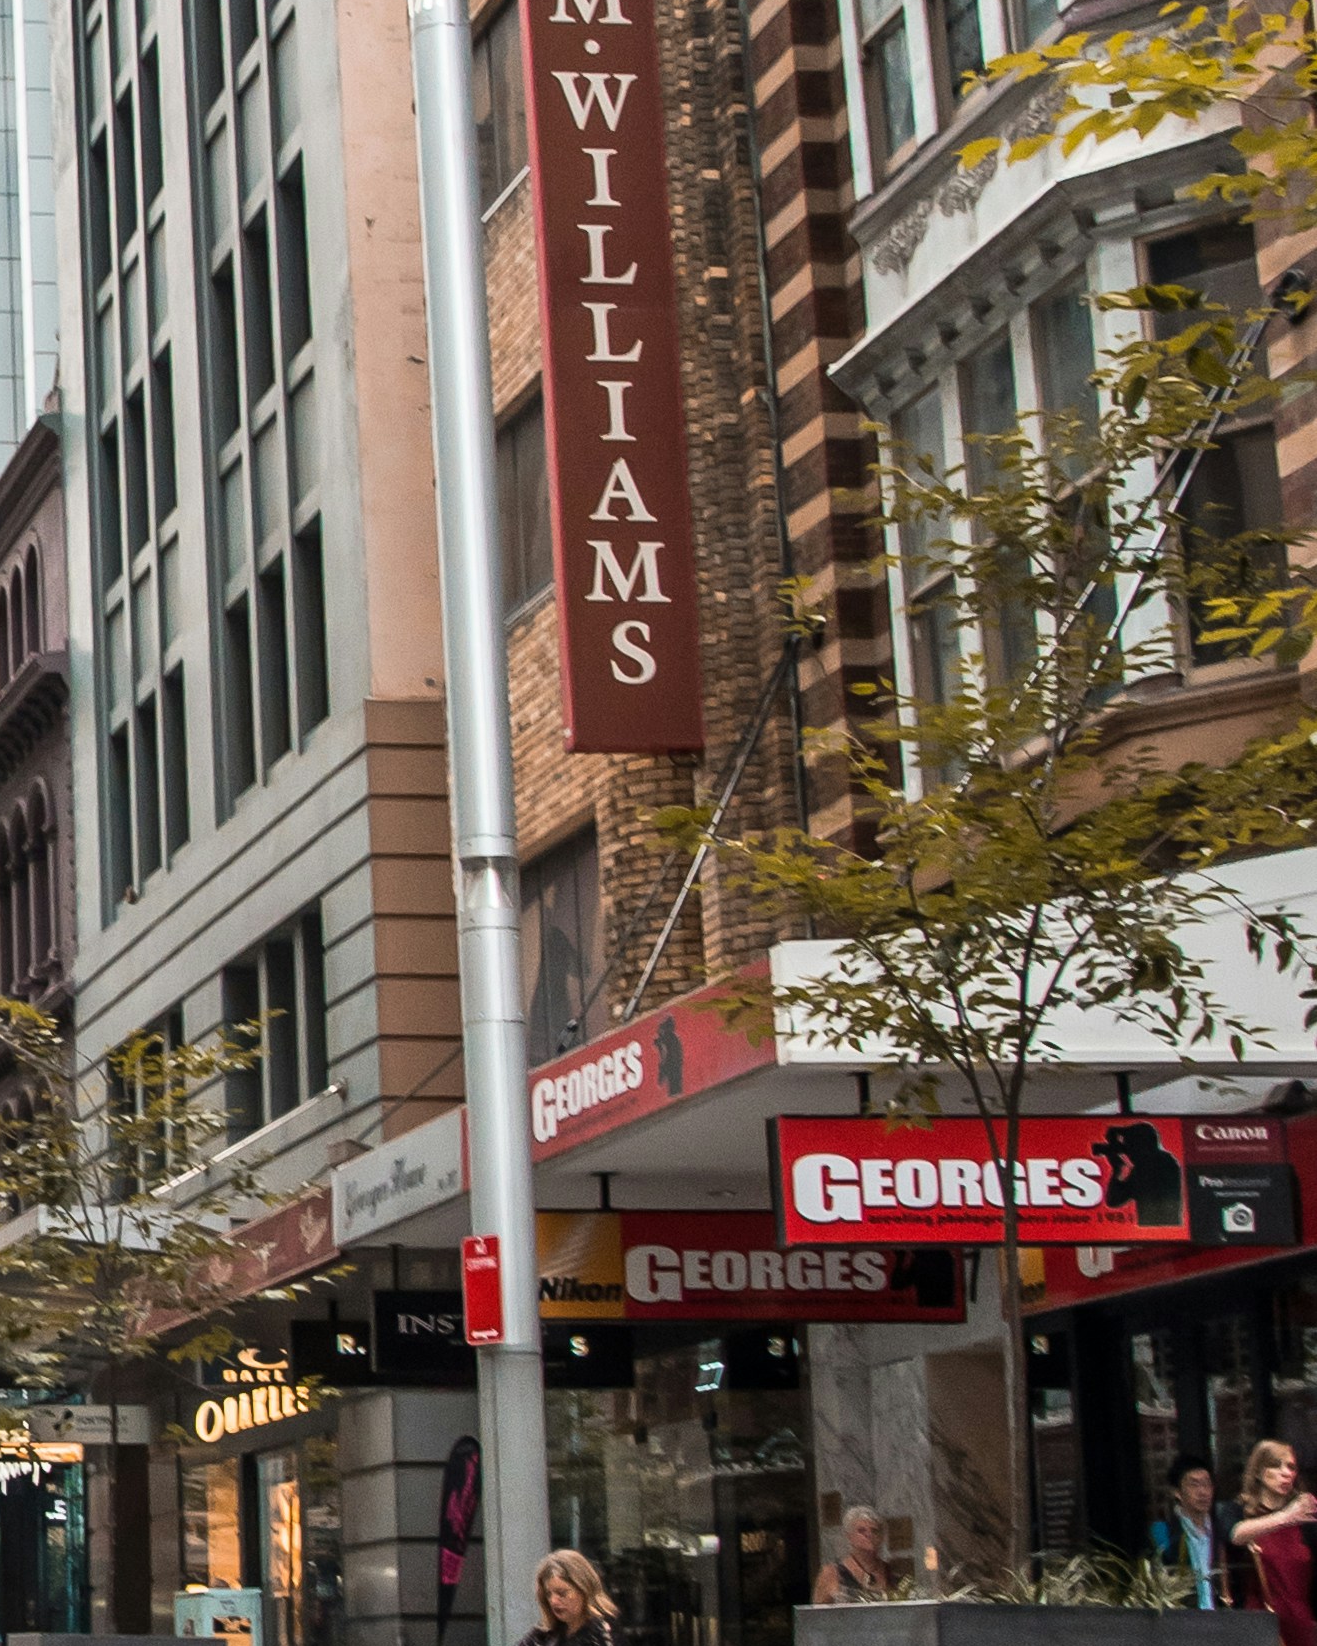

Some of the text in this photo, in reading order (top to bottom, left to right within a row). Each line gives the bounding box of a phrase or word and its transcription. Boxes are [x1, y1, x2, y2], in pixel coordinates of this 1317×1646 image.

[532, 1040, 644, 1144] GEORGES
[1195, 1124, 1269, 1141] Canon
[792, 1152, 1105, 1224] GEORGES
[538, 1276, 622, 1303] Nikon
[625, 1244, 887, 1304] GEORGES
